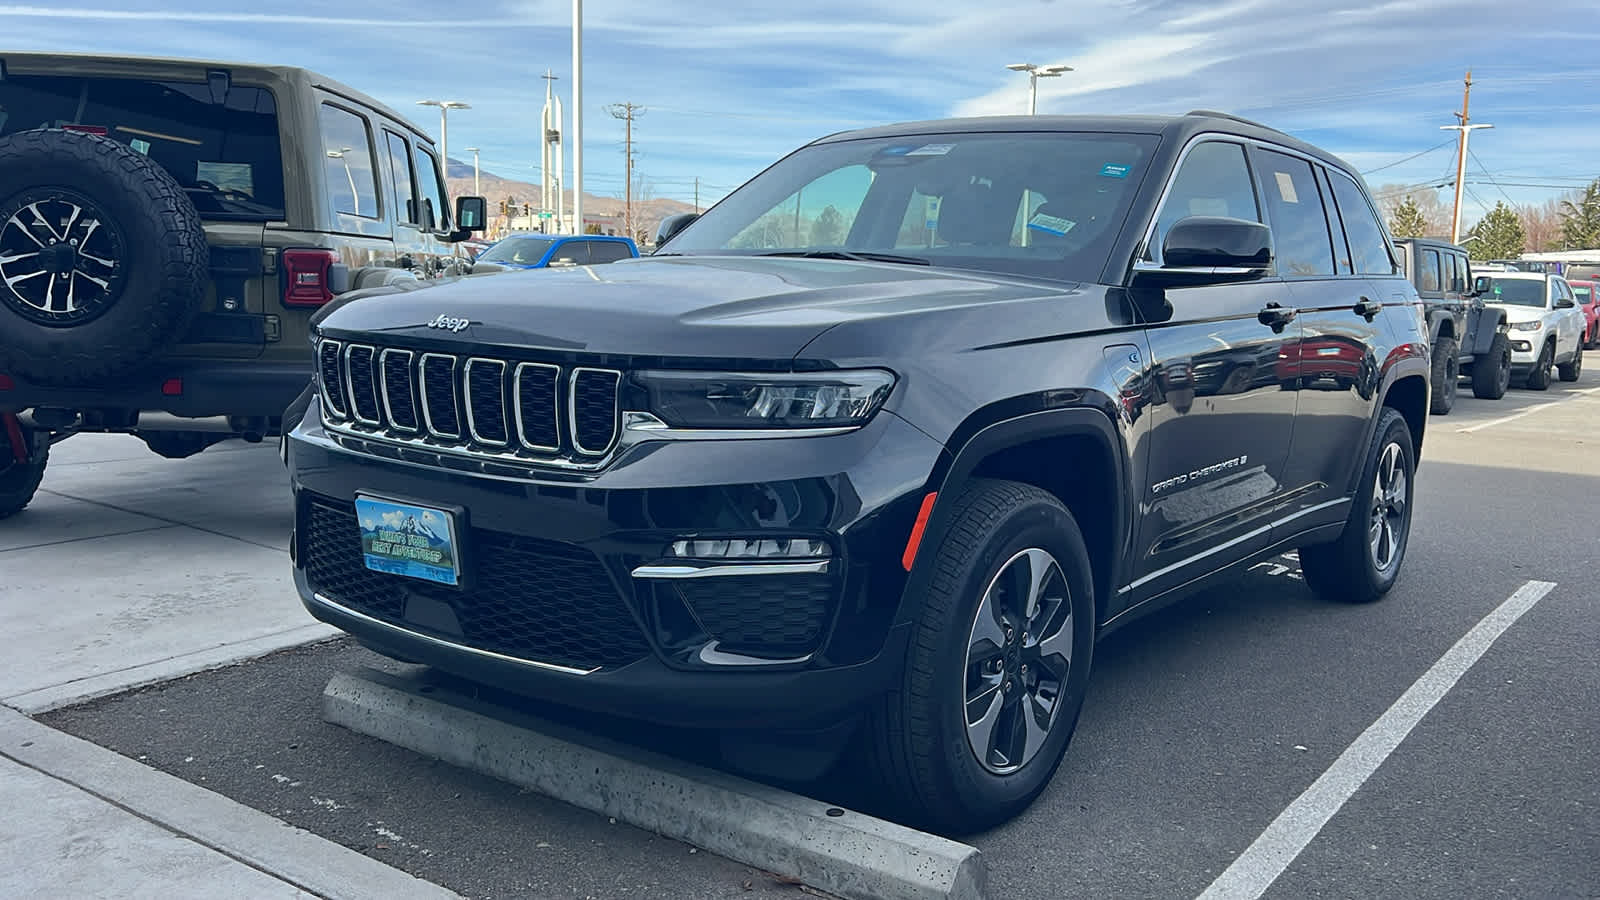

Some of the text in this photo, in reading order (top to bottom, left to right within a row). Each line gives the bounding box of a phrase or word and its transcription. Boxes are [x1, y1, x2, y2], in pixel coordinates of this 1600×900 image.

[427, 313, 469, 333] Jeep
[1152, 457, 1239, 493] GRAND CHEROKEE
[371, 540, 442, 563] NEXT ADVENTURE?
[407, 534, 430, 548] YOUR
